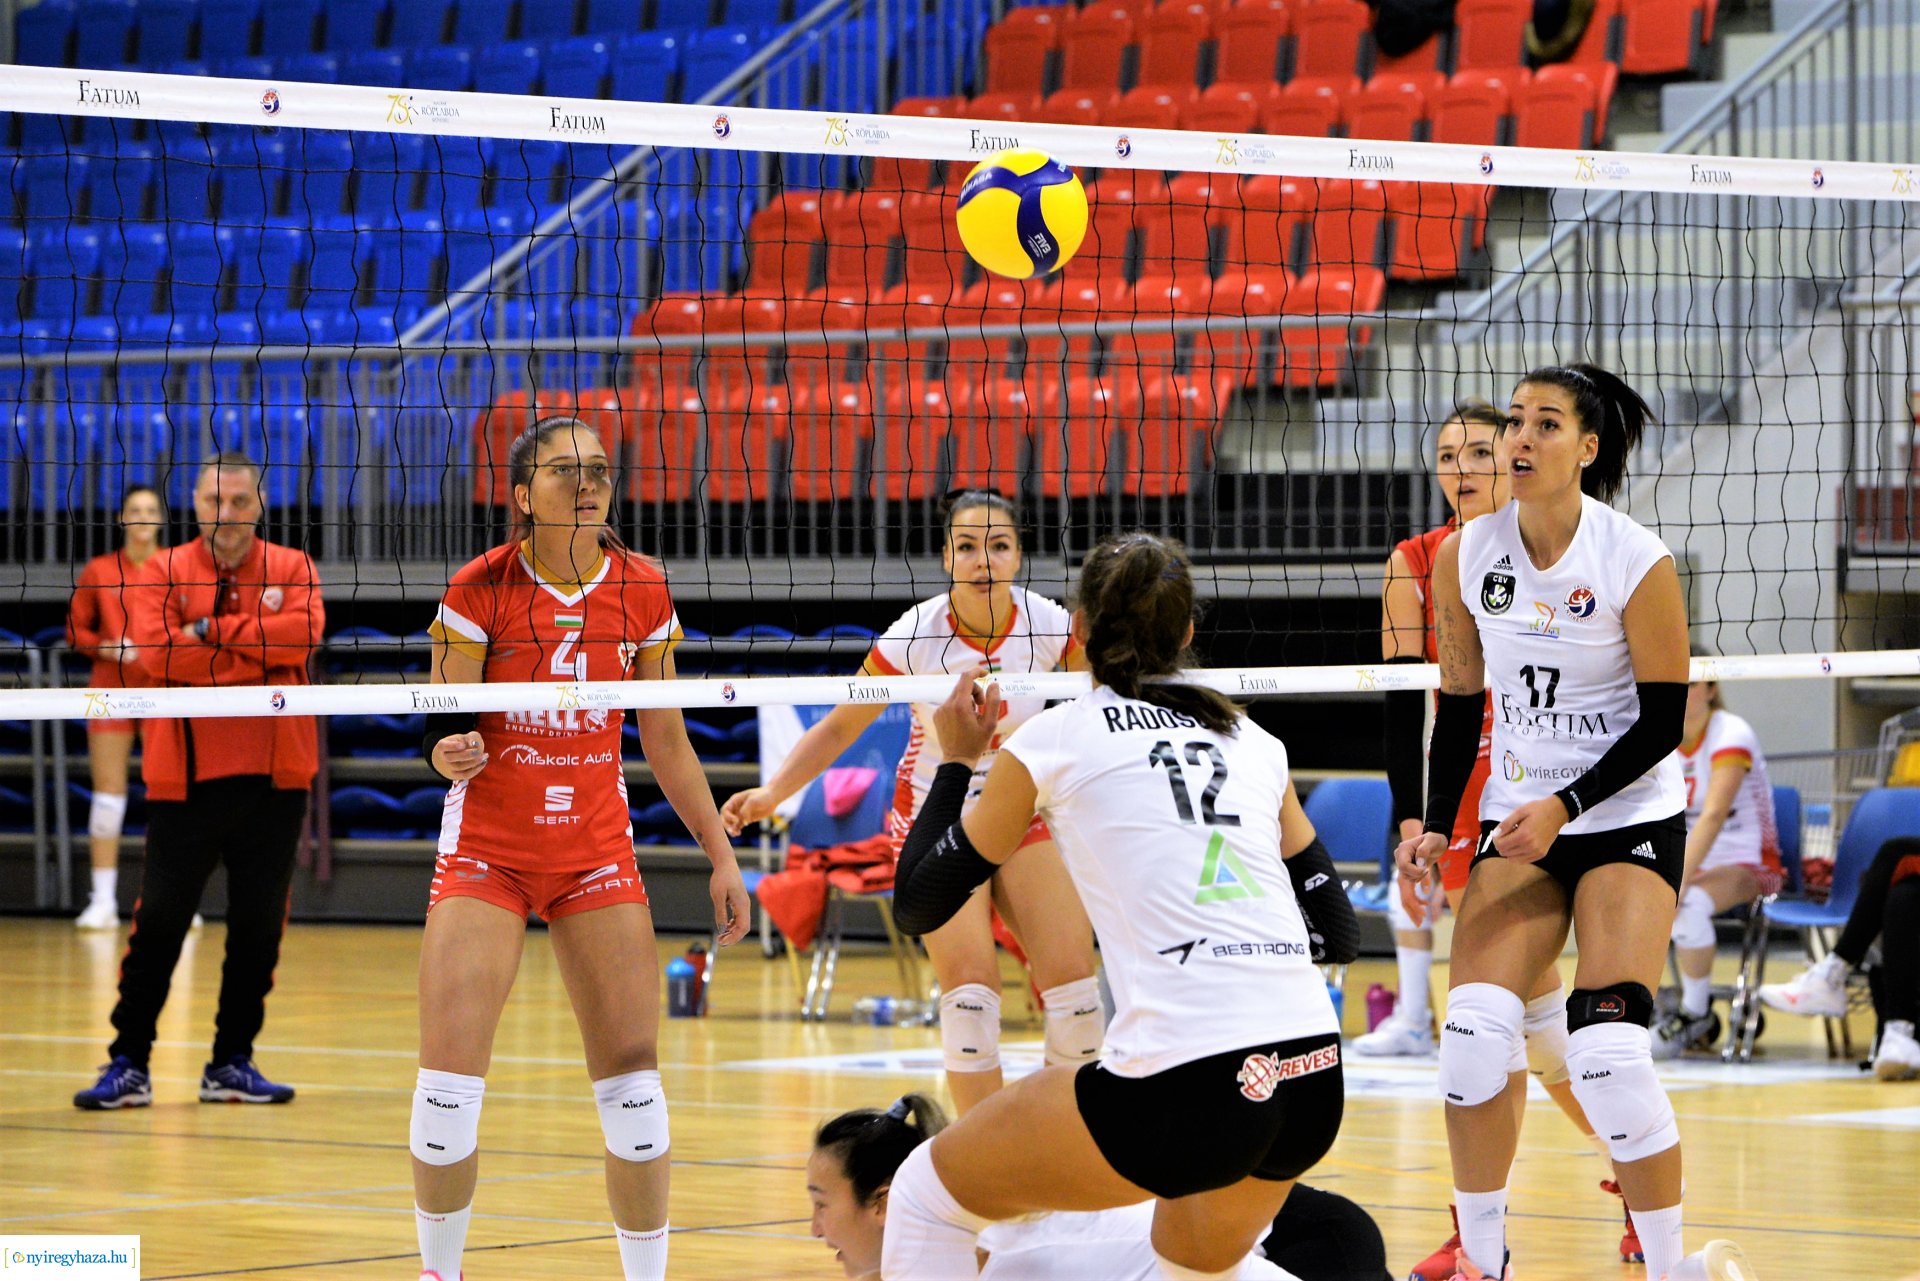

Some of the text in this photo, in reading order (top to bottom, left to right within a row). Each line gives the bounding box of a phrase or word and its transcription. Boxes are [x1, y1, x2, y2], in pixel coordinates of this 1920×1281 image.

[77, 79, 141, 105] FATUM
[550, 105, 606, 131] FATUM
[969, 129, 1020, 150] FATUM
[1349, 149, 1394, 169] FATUM
[1691, 164, 1732, 184] FATUM
[1034, 232, 1052, 254] FIVB
[1493, 563, 1514, 571] adidas
[1492, 574, 1509, 584] CEV
[550, 631, 588, 682] 4
[848, 682, 890, 699] FATUM
[1239, 674, 1278, 690] FATUM
[1519, 664, 1561, 709] 17
[411, 691, 459, 709] FATUM
[1102, 704, 1242, 733] RADOS
[505, 723, 545, 735] ENERGY
[516, 749, 613, 766] Miskolc Autó
[1526, 766, 1591, 780] NYÍREGYH
[1149, 740, 1242, 827] 12
[533, 815, 581, 825] SEAT
[1631, 848, 1657, 860] adidas
[1212, 942, 1306, 958] BESTRONG
[1278, 1046, 1338, 1079] REVESZ
